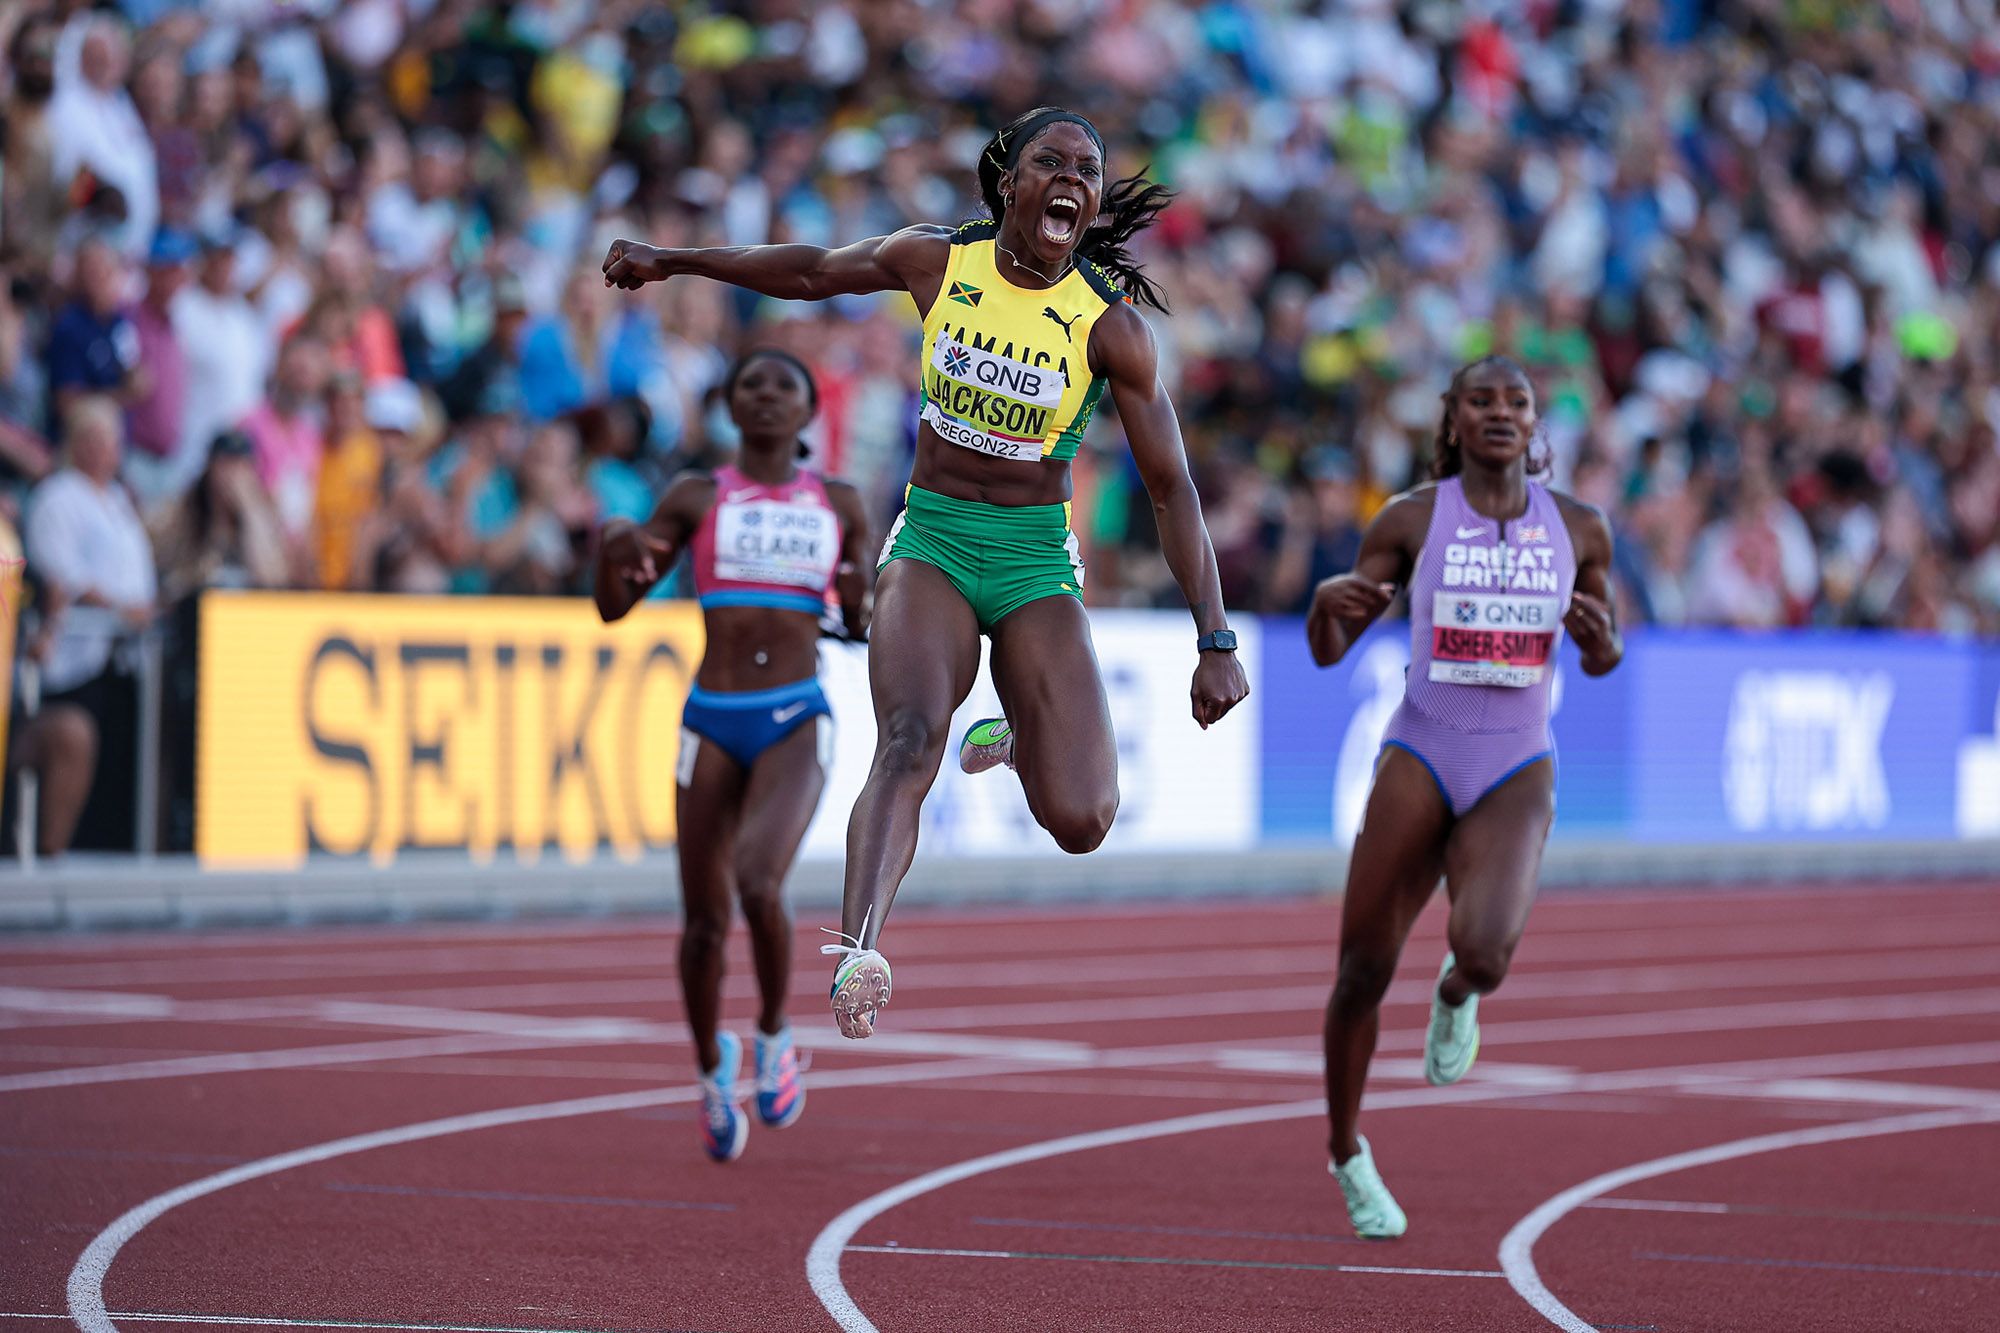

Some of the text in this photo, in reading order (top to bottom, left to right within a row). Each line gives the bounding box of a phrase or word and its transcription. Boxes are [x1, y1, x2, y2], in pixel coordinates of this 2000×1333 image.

[975, 360, 1042, 397] QNB
[931, 374, 1047, 435] JACKSON
[735, 530, 819, 560] CLARK
[1445, 543, 1555, 570] GREAT
[1442, 564, 1559, 593] BRITAIN
[1484, 604, 1543, 626] QNB
[303, 636, 691, 858] SEIKO
